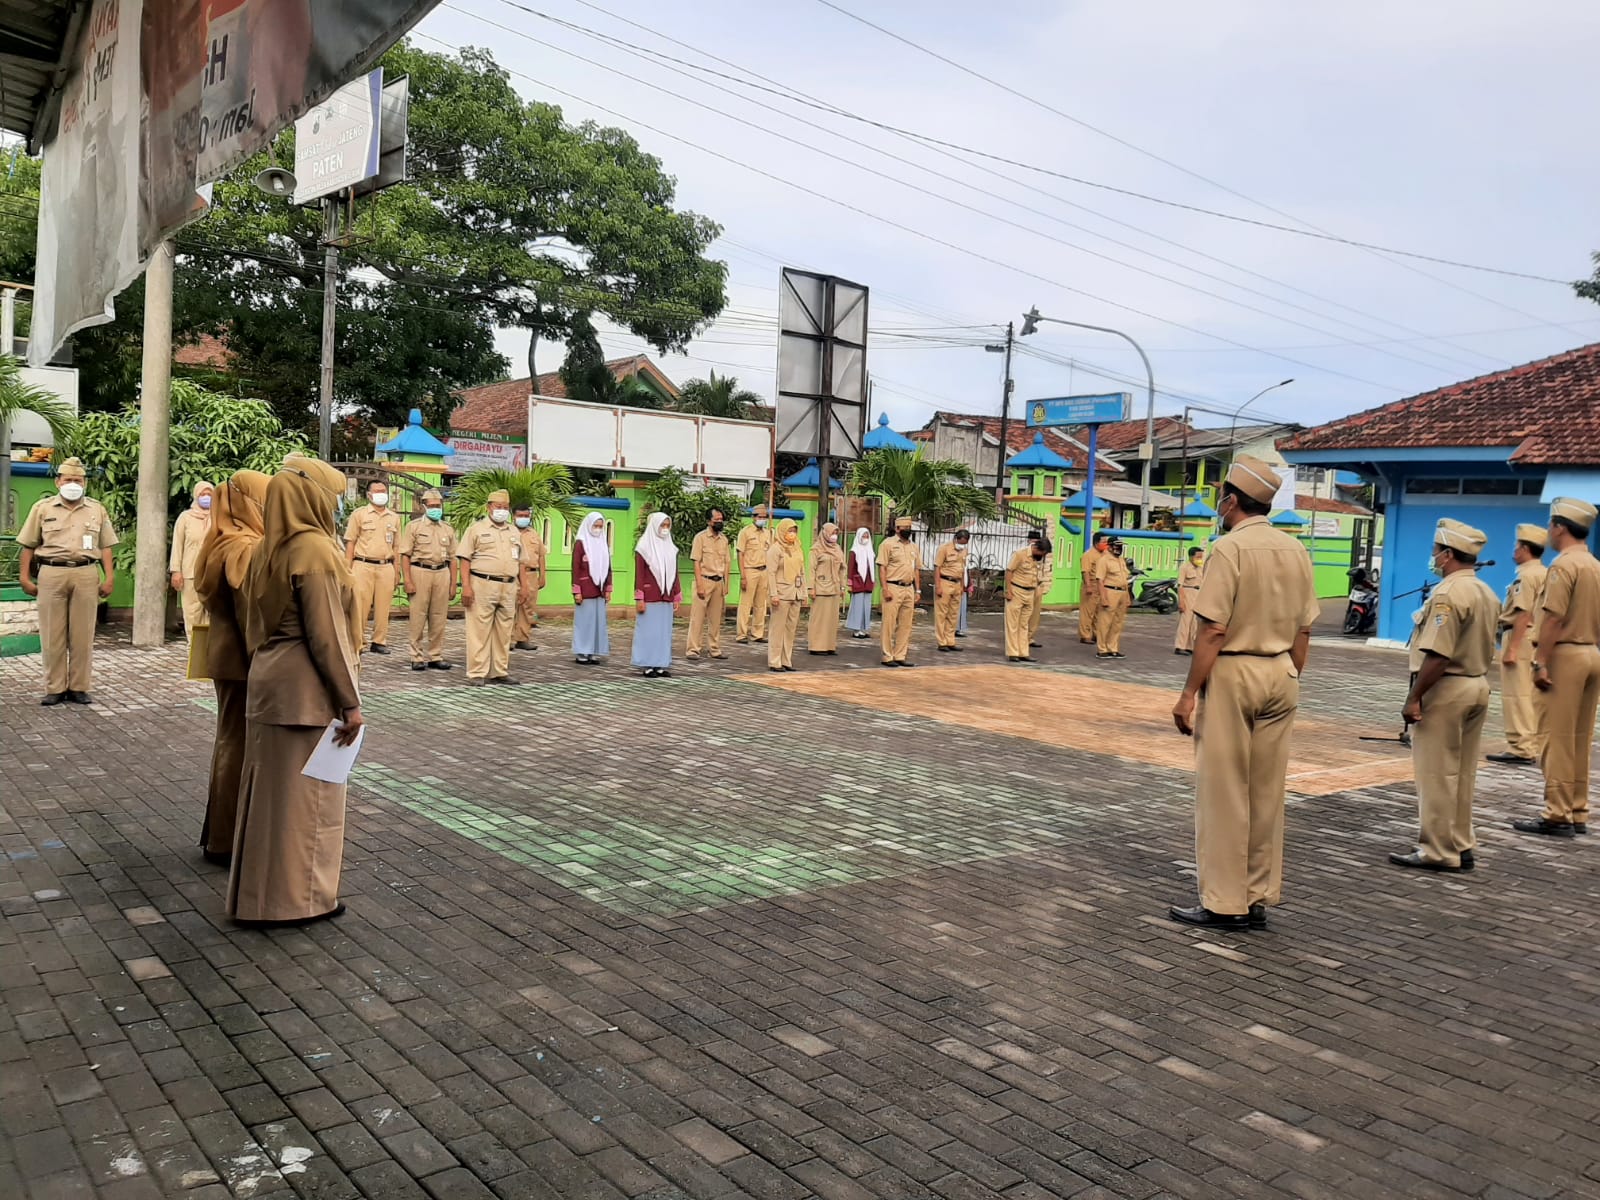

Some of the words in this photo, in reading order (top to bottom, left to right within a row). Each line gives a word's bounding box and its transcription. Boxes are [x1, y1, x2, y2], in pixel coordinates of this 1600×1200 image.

[338, 124, 365, 146] JATENG
[313, 151, 345, 179] PATEN
[453, 440, 503, 453] DIRGAHAYU
